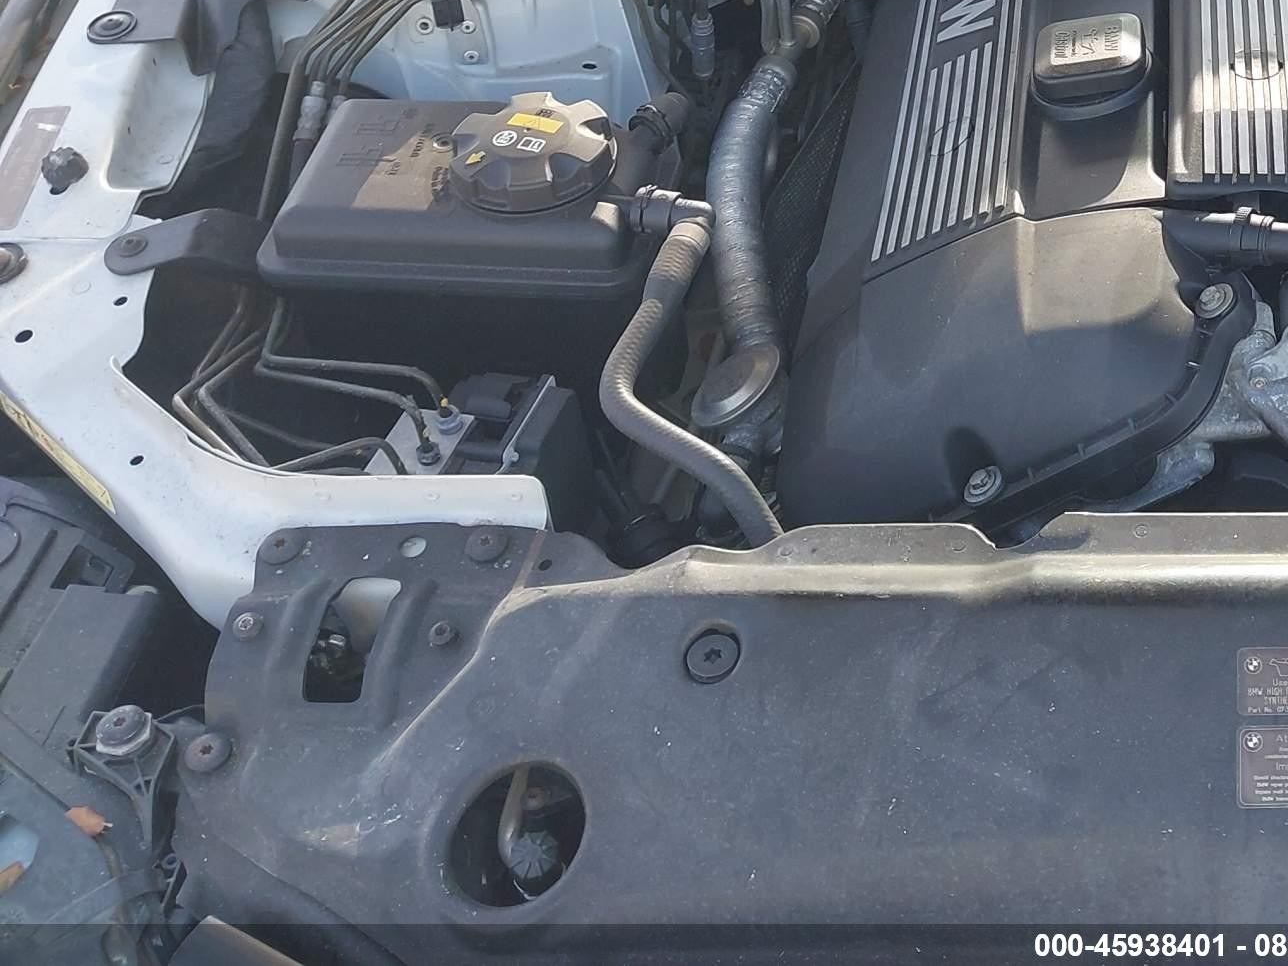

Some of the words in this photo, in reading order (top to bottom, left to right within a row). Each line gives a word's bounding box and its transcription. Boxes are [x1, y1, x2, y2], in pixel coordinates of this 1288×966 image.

[1053, 30, 1071, 59] Castrol
[1272, 678, 1288, 686] Use
[1247, 687, 1264, 696] BMW
[1266, 687, 1283, 696] HIGH
